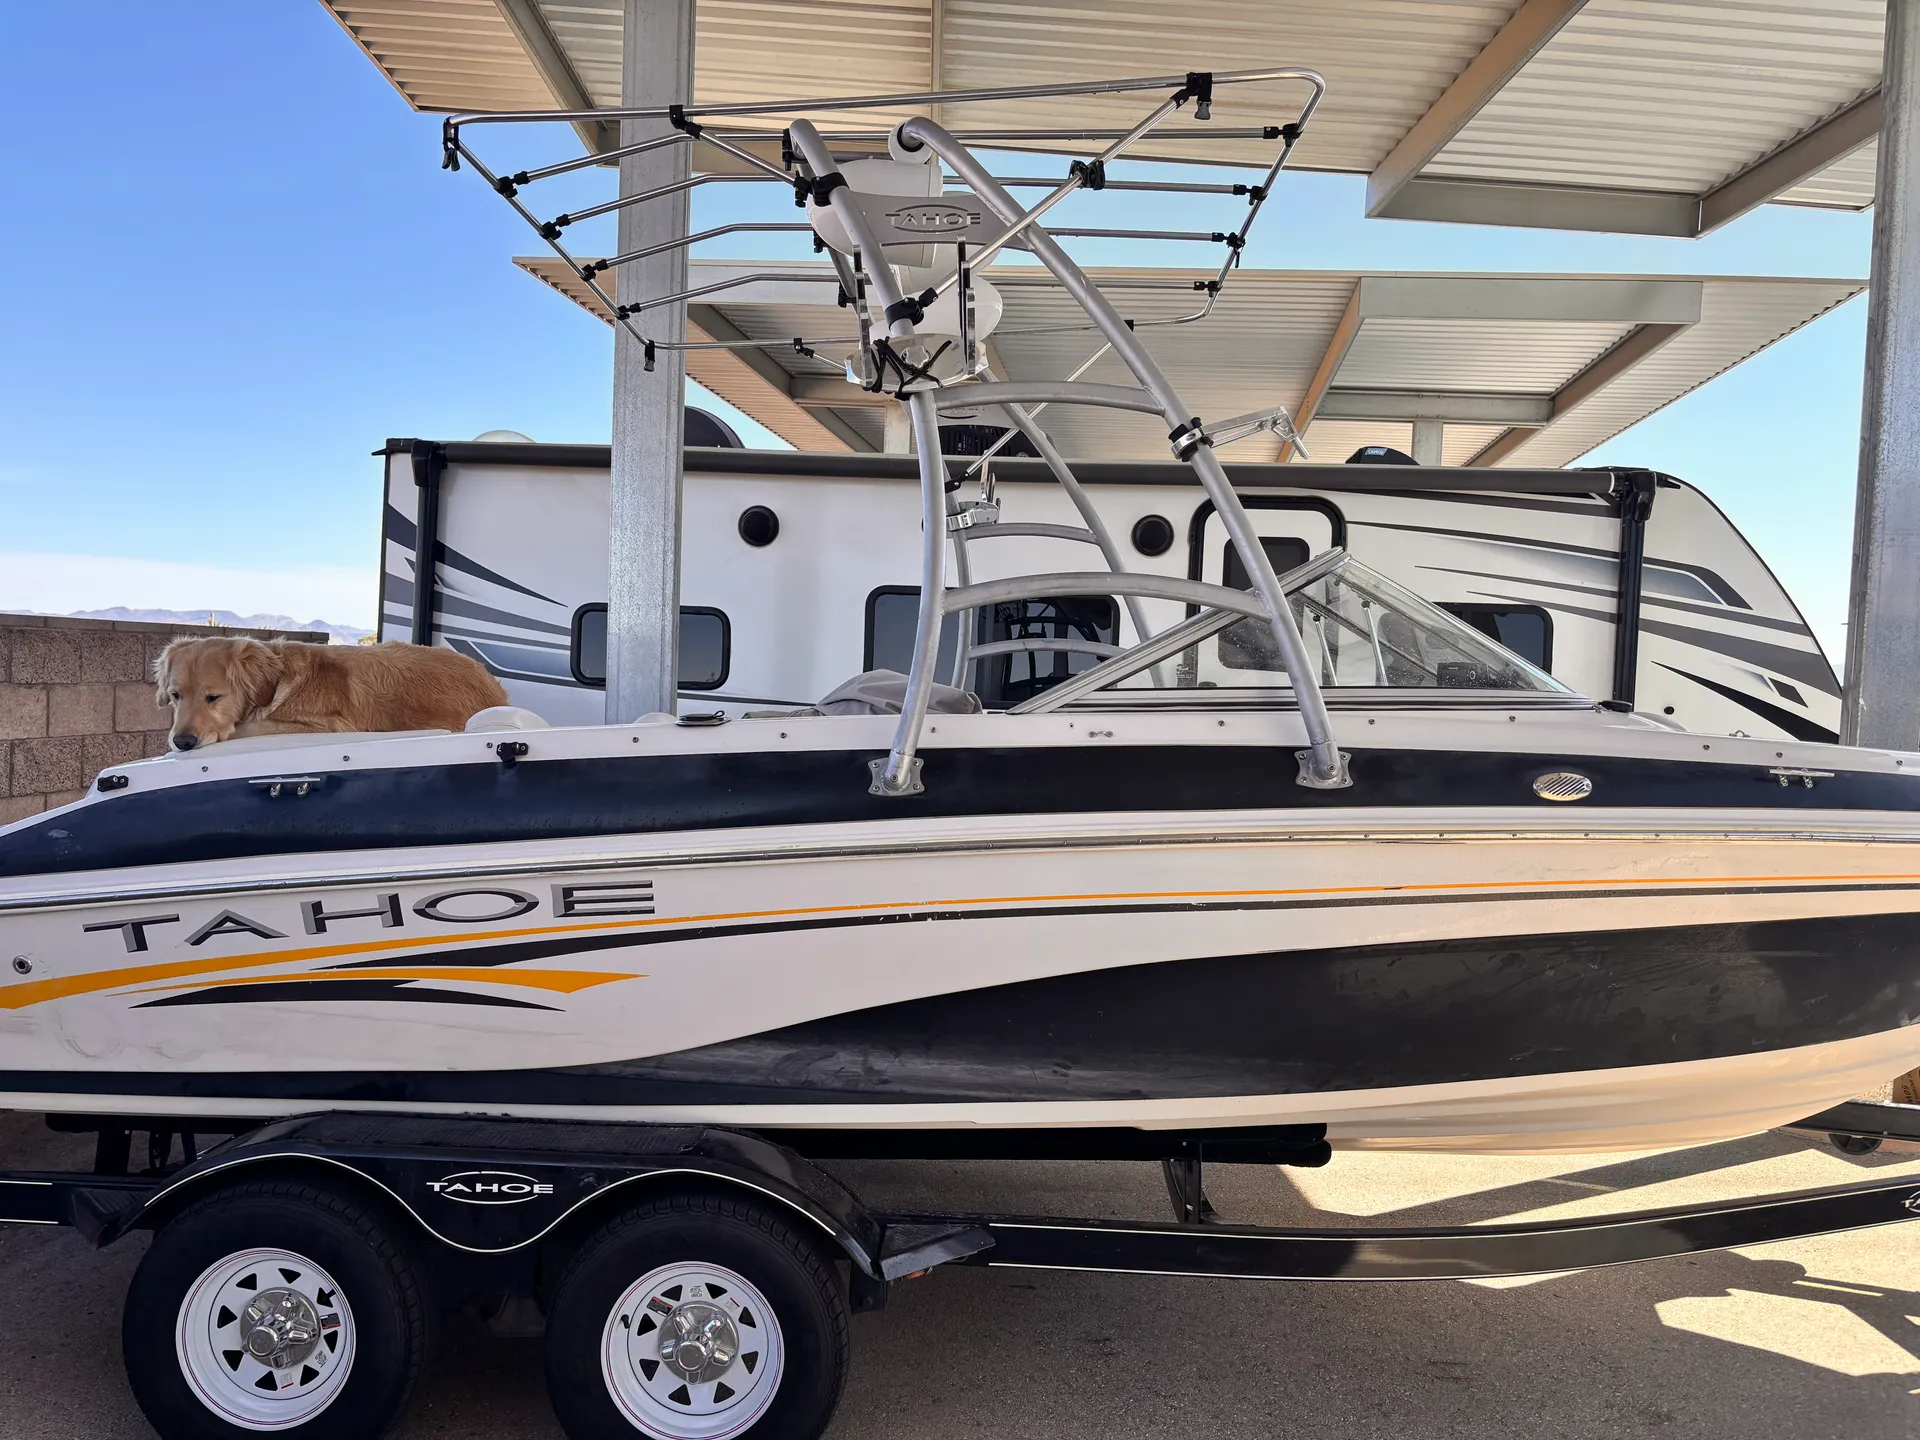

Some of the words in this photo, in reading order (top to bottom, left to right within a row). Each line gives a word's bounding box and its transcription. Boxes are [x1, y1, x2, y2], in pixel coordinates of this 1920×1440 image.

[885, 212, 981, 226] TAHOE
[82, 880, 655, 953] TAHOE
[426, 1182, 554, 1194] TAHOE
